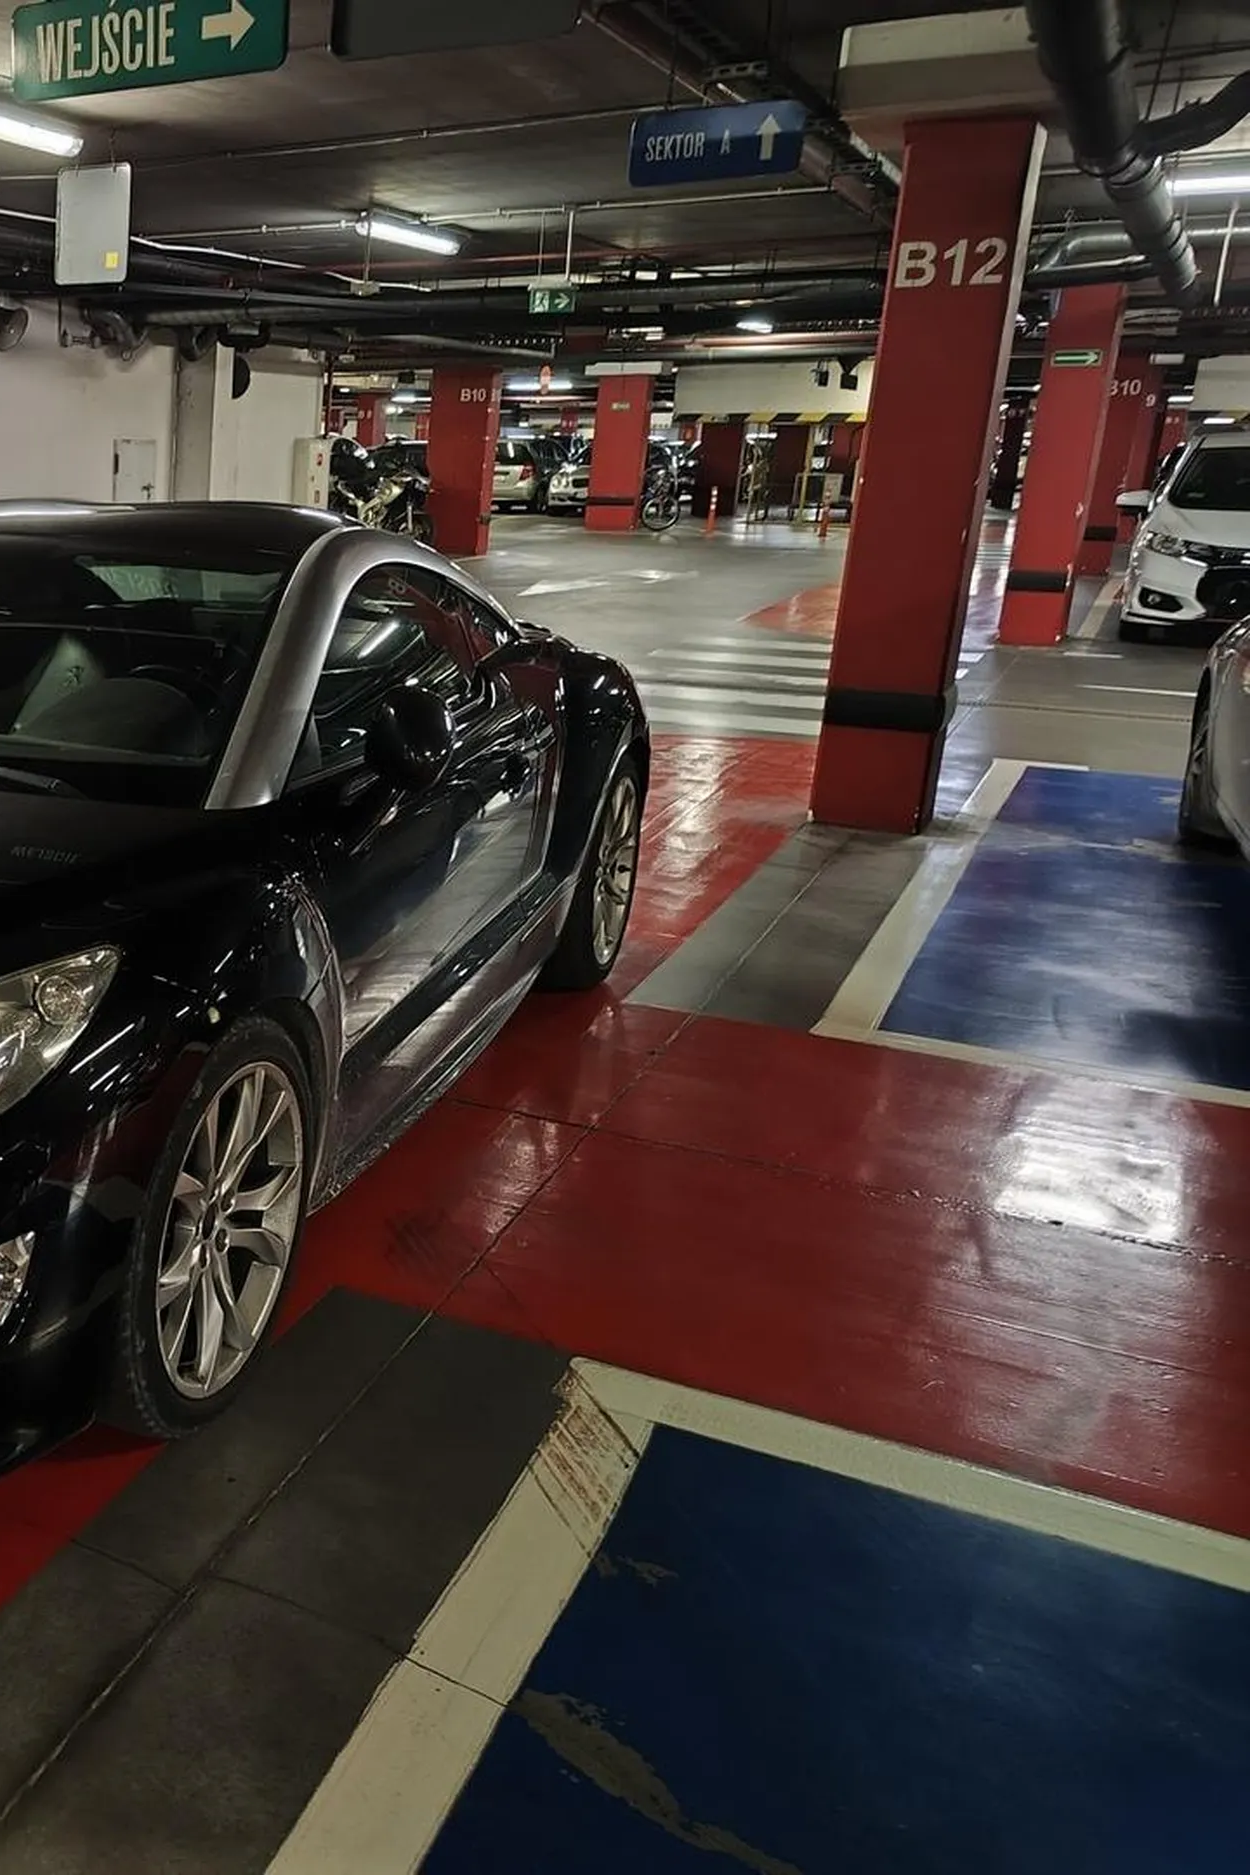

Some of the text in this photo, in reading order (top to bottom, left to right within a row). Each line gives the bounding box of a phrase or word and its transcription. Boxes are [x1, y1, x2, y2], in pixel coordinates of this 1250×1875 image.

[36, 0, 176, 84] WEJŚCIE
[645, 128, 731, 163] SEKTOR A
[894, 237, 1008, 288] B12
[460, 388, 487, 402] B10
